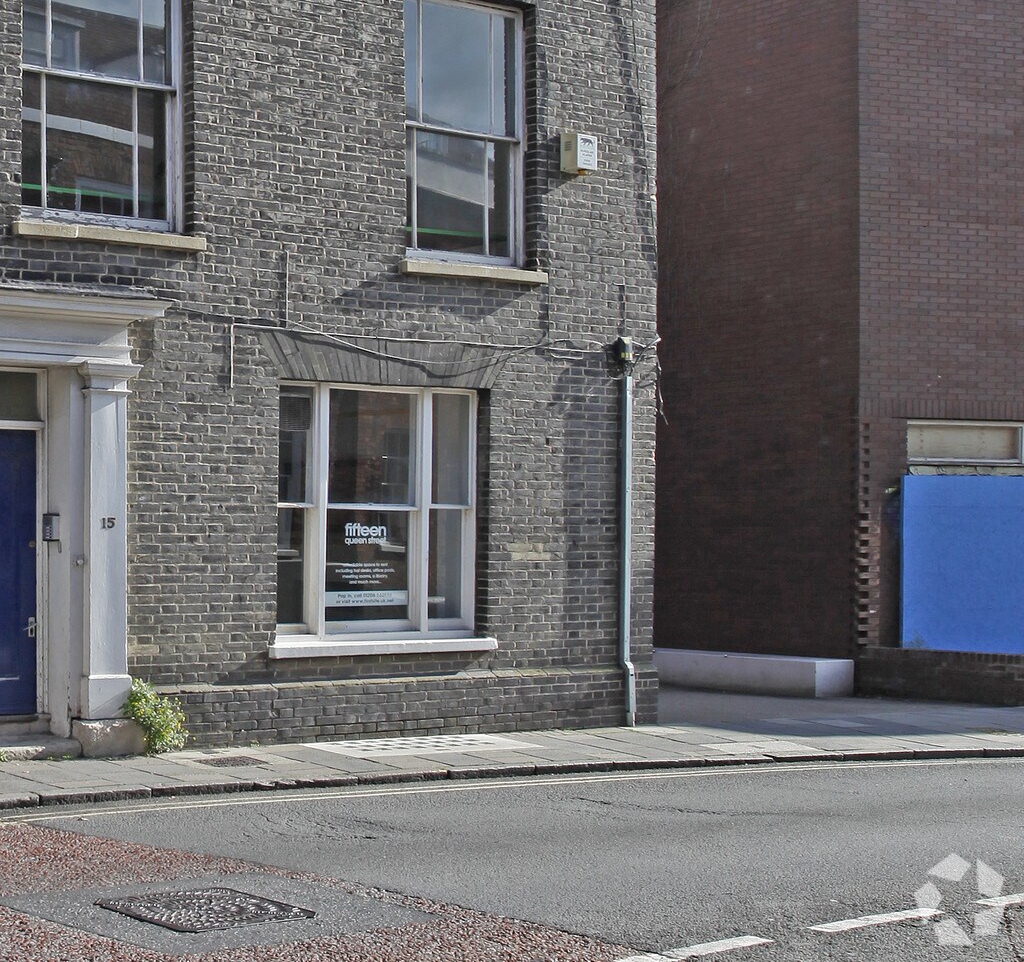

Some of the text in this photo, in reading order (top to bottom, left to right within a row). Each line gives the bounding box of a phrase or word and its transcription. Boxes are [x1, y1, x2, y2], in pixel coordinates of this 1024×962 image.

[101, 517, 116, 529] 15
[345, 522, 387, 537] fifteen
[345, 536, 387, 545] queen street
